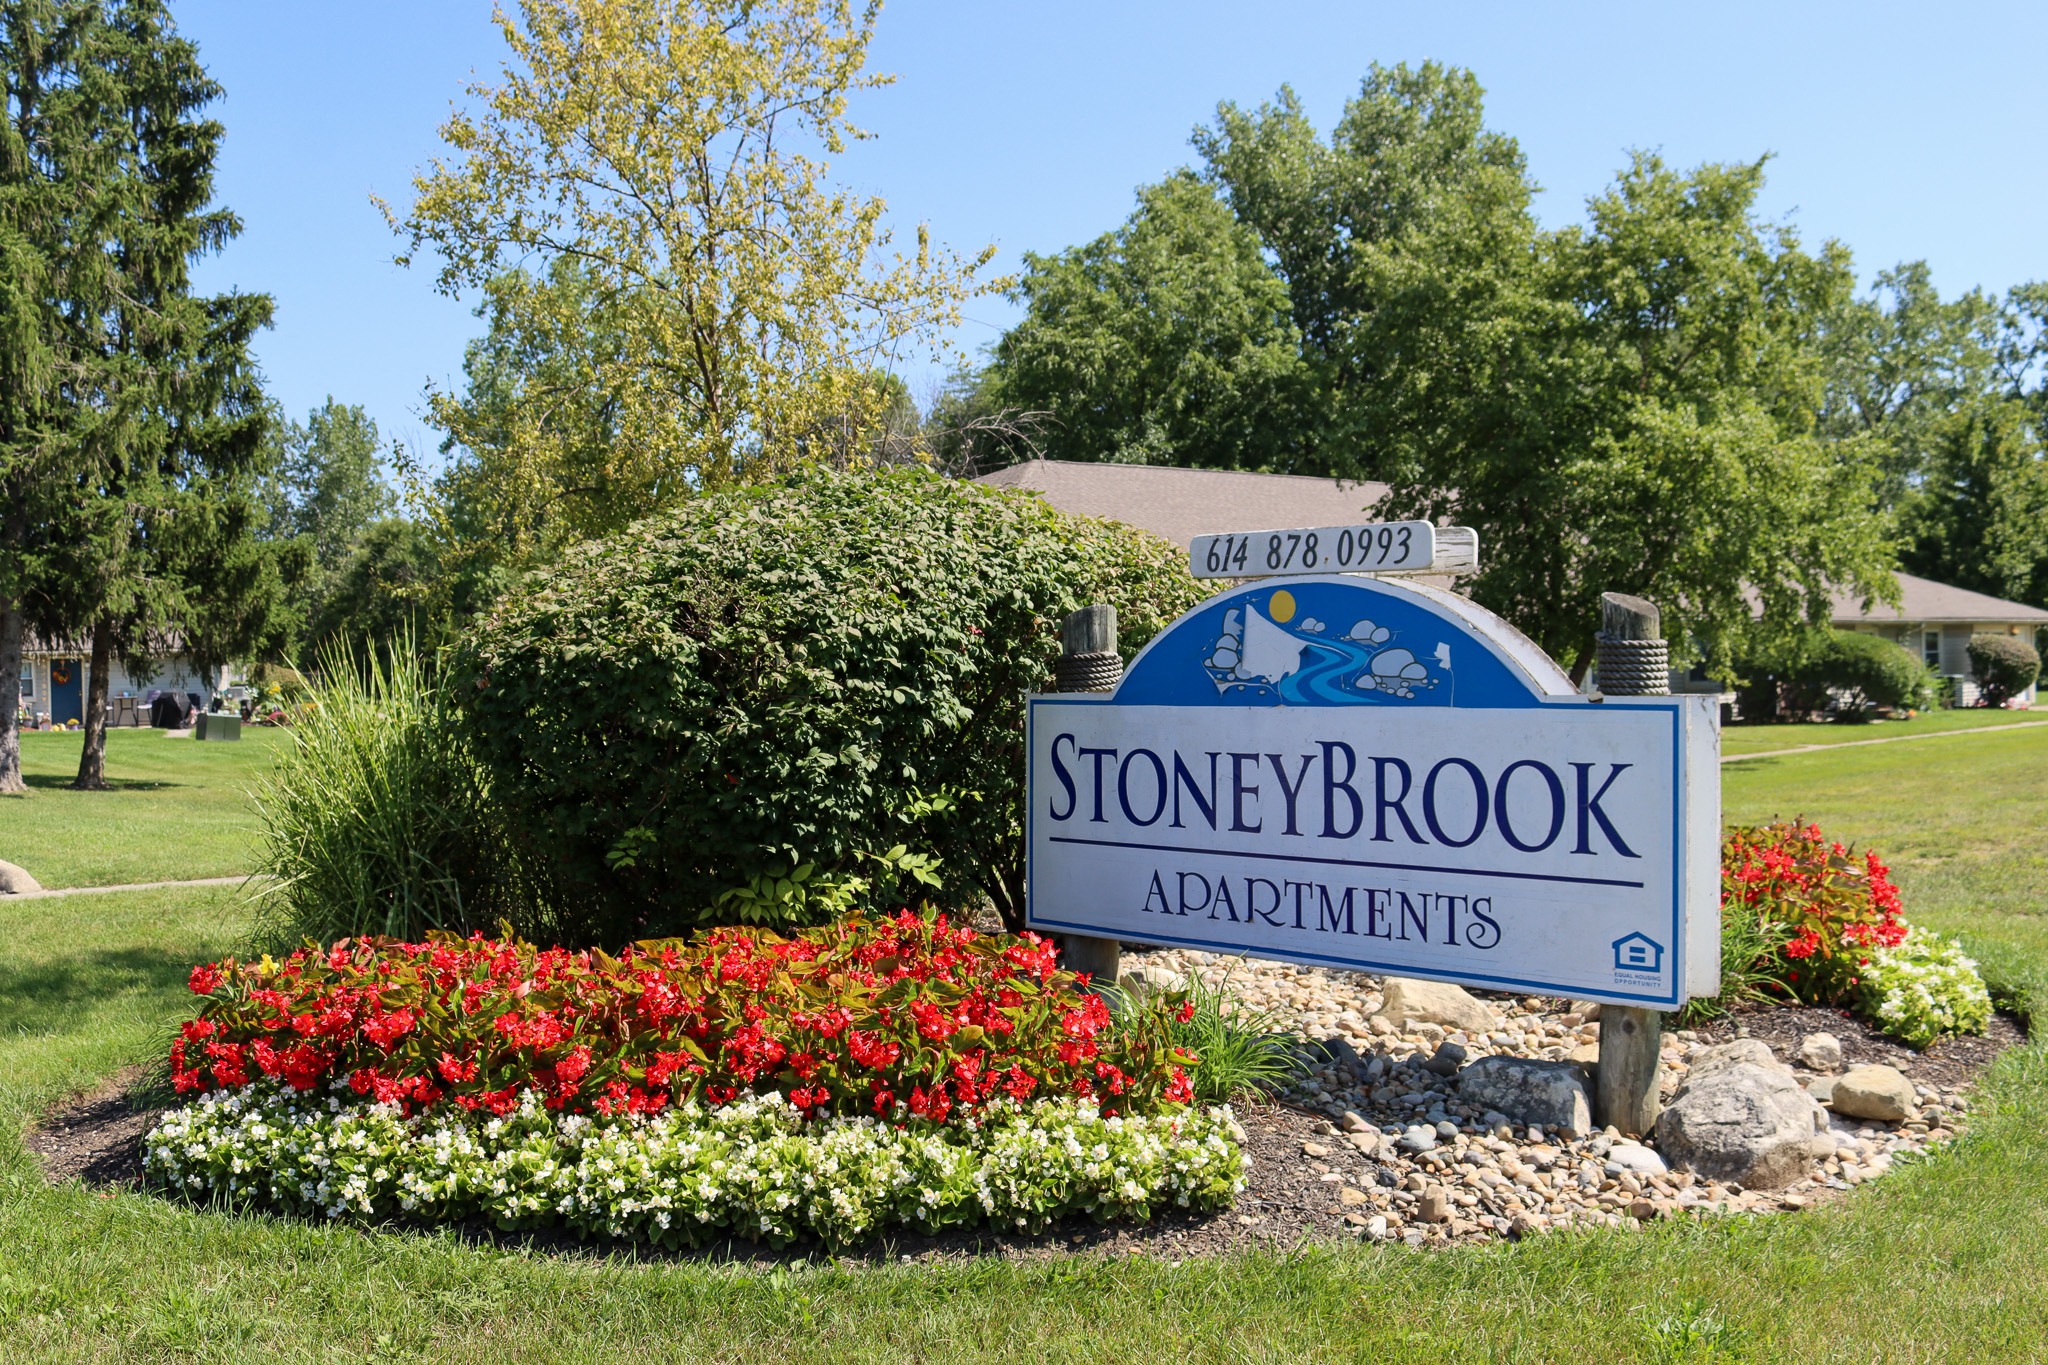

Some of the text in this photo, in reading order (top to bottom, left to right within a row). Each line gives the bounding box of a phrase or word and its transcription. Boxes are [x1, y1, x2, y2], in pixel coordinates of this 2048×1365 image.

[1206, 526, 1412, 573] 614 878 0993
[1049, 732, 1642, 859] STONEYBROOK
[1141, 868, 1502, 950] APARTMENTS
[1614, 978, 1662, 987] OPPORTUNITY
[1634, 974, 1662, 982] HOUSING
